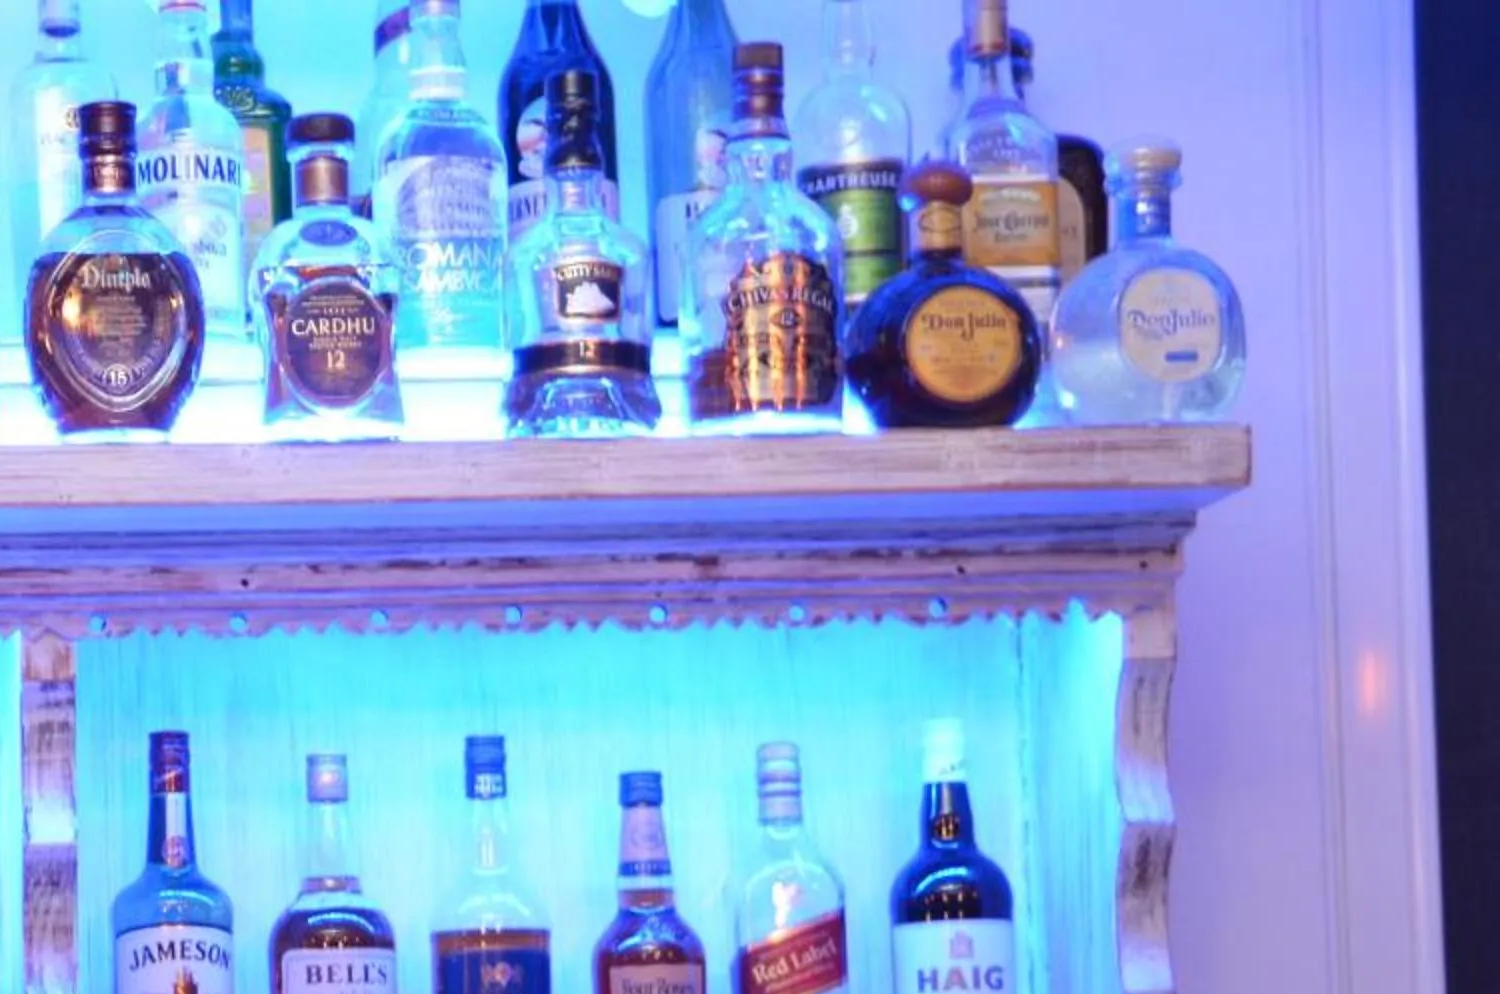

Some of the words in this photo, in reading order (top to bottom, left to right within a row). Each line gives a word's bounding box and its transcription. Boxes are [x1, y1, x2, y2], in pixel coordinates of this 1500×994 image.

[138, 153, 241, 185] MOLINARI
[291, 317, 376, 337] CARDHU
[325, 350, 346, 369] 12
[109, 371, 128, 386] 15
[128, 938, 230, 971] JAMESON
[305, 962, 389, 986] BELL'S
[752, 959, 790, 985] Red
[916, 965, 1004, 994] HAIG
